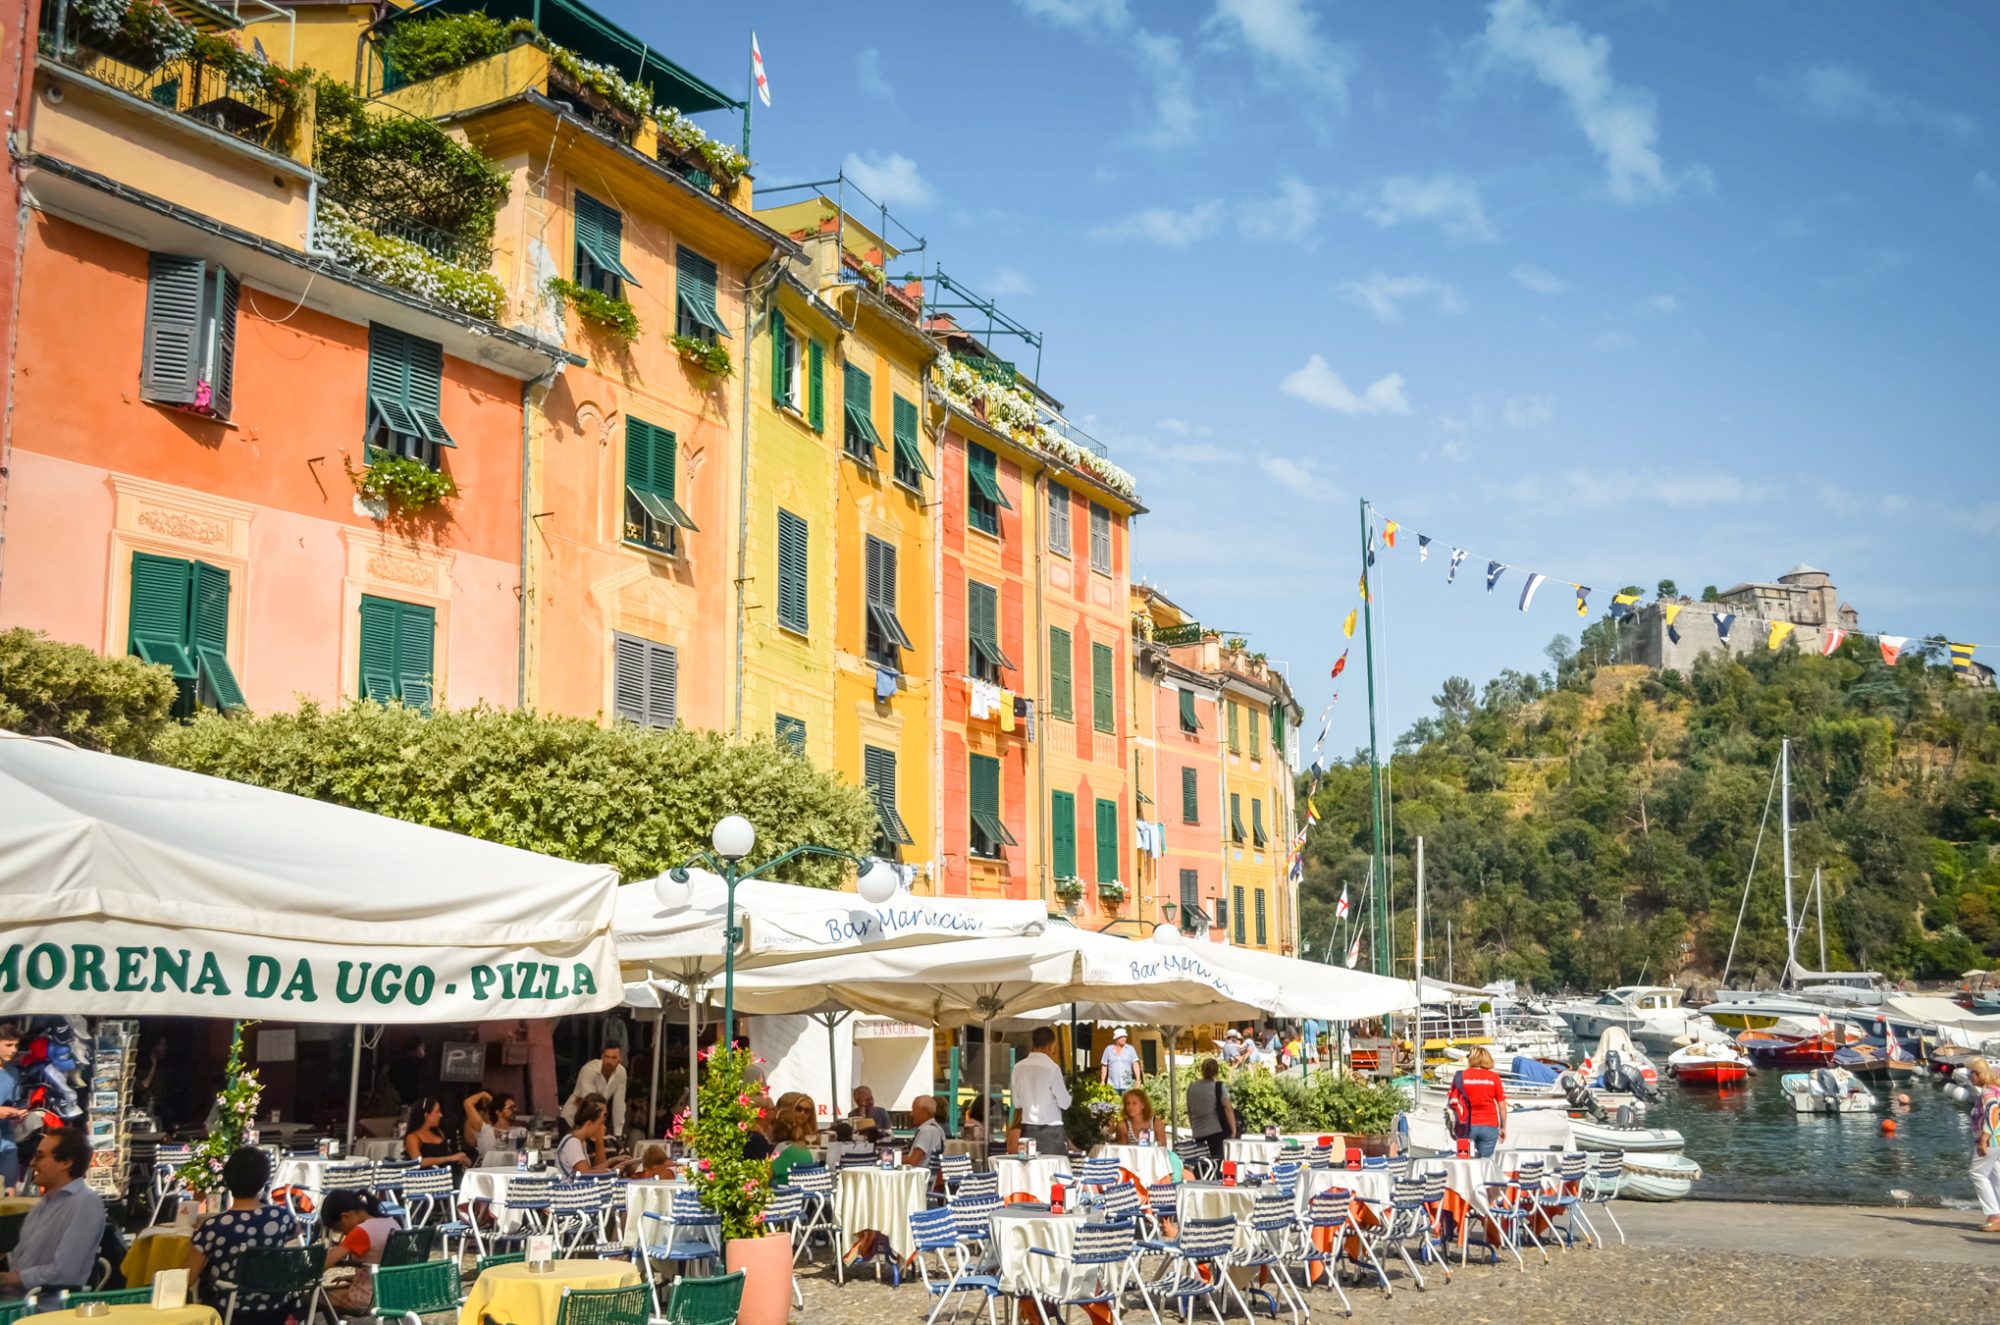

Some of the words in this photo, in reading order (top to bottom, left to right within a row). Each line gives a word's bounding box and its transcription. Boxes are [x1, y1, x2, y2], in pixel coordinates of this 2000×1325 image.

[826, 917, 871, 942] Bar
[244, 954, 318, 1002] DA
[336, 961, 436, 1006] UGO
[471, 961, 597, 1001] PIZZA
[1129, 961, 1159, 981] Bar
